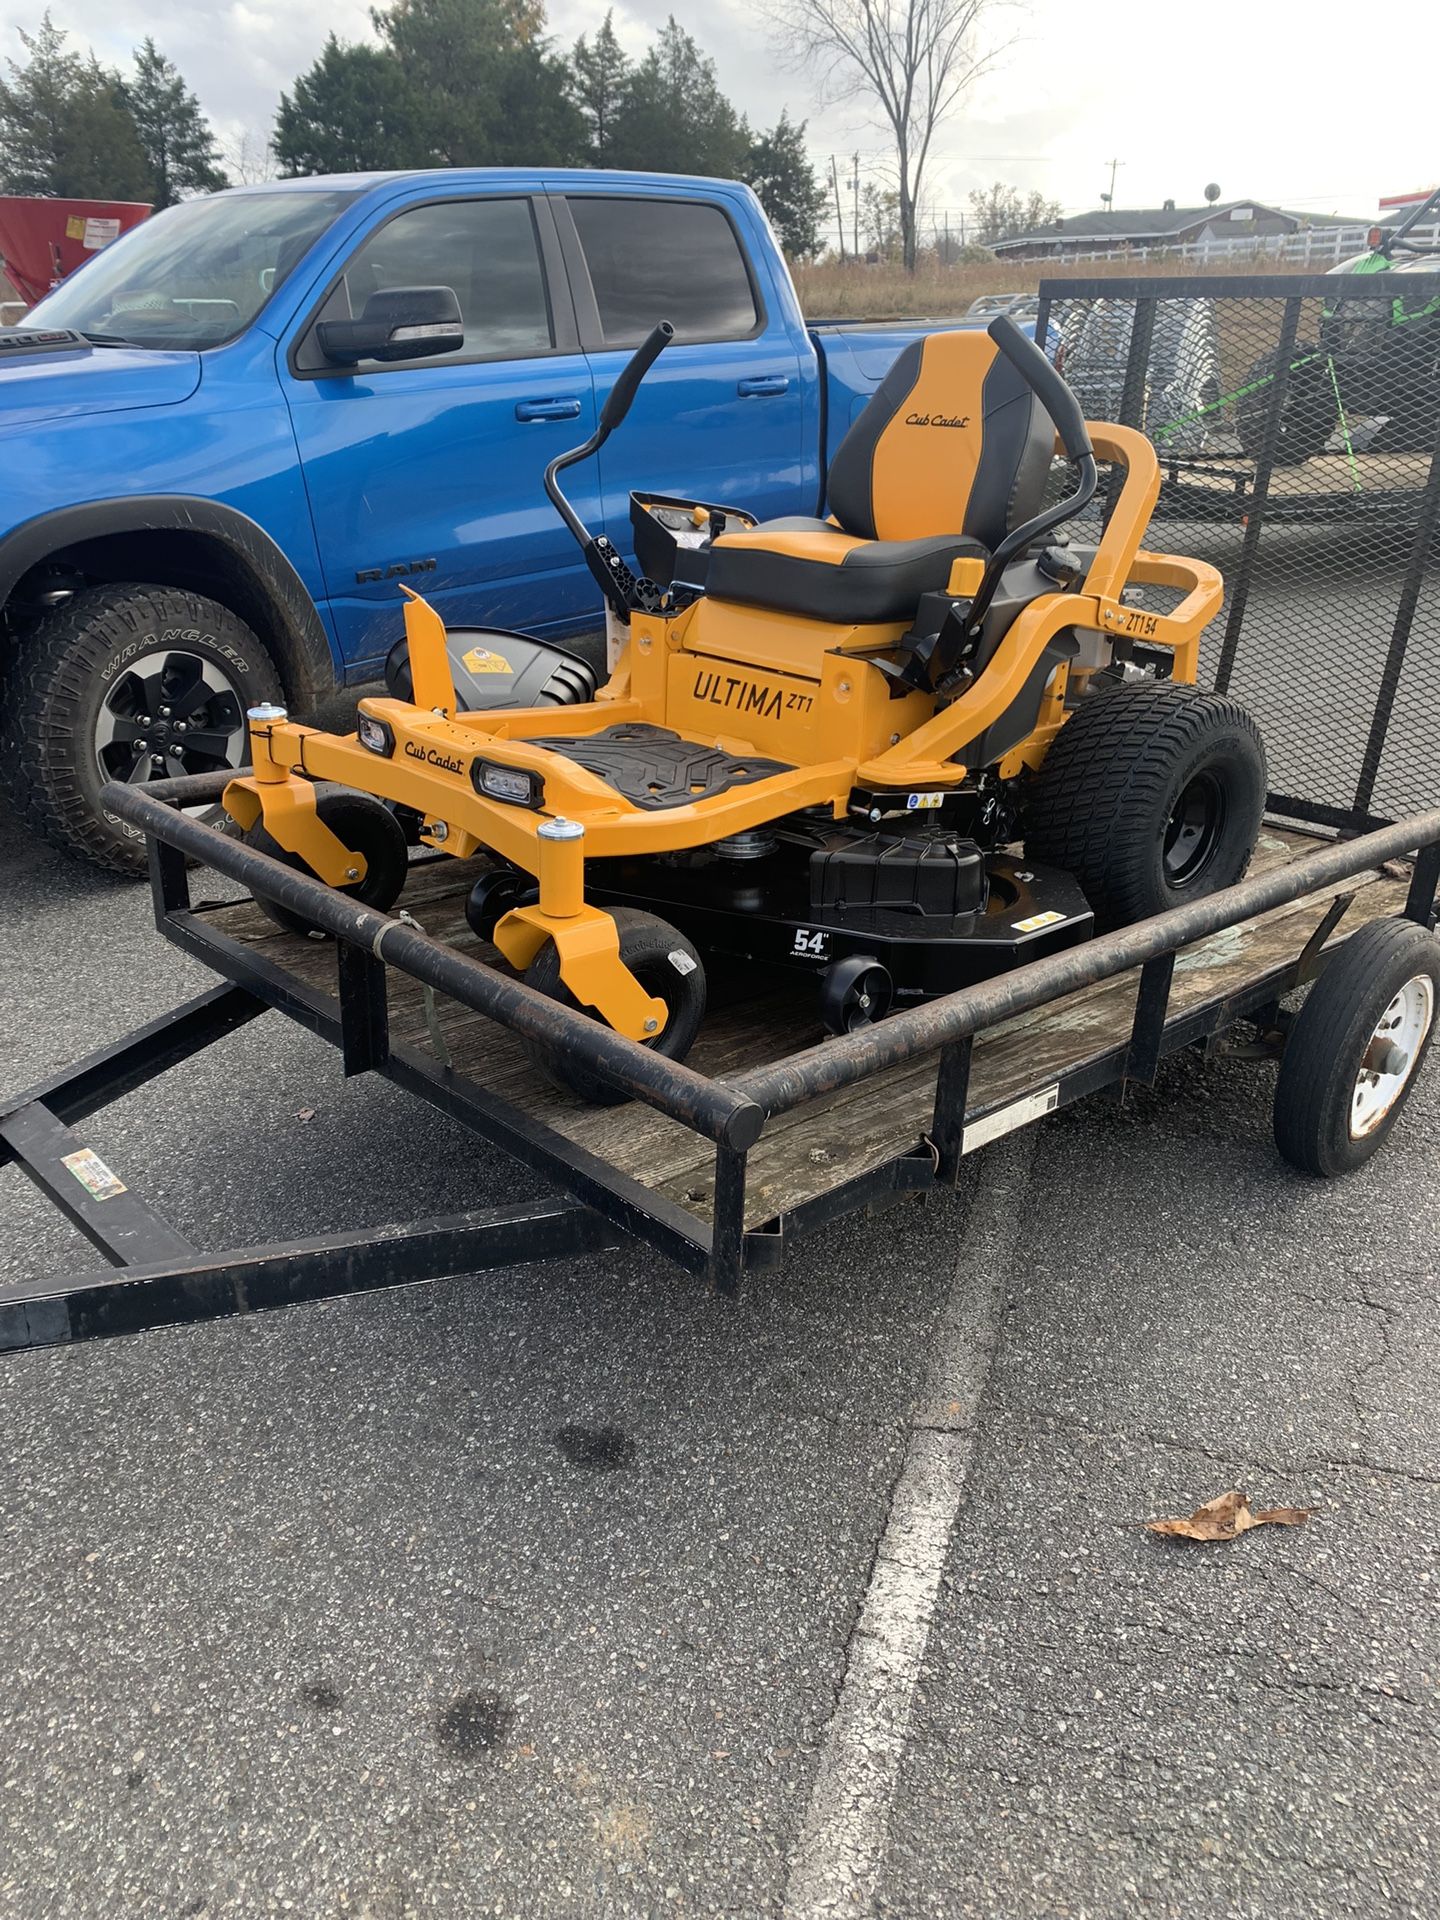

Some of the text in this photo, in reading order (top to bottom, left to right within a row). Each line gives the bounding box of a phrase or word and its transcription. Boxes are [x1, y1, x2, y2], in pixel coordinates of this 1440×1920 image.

[905, 413, 970, 428] Cub Cadet
[355, 558, 437, 584] RAM
[101, 628, 250, 681] WRANGLER
[693, 671, 814, 720] ULTIMA ZT1
[404, 740, 465, 775] Cub Cadet
[794, 928, 830, 954] 54"
[789, 950, 829, 961] AEROFORCE
